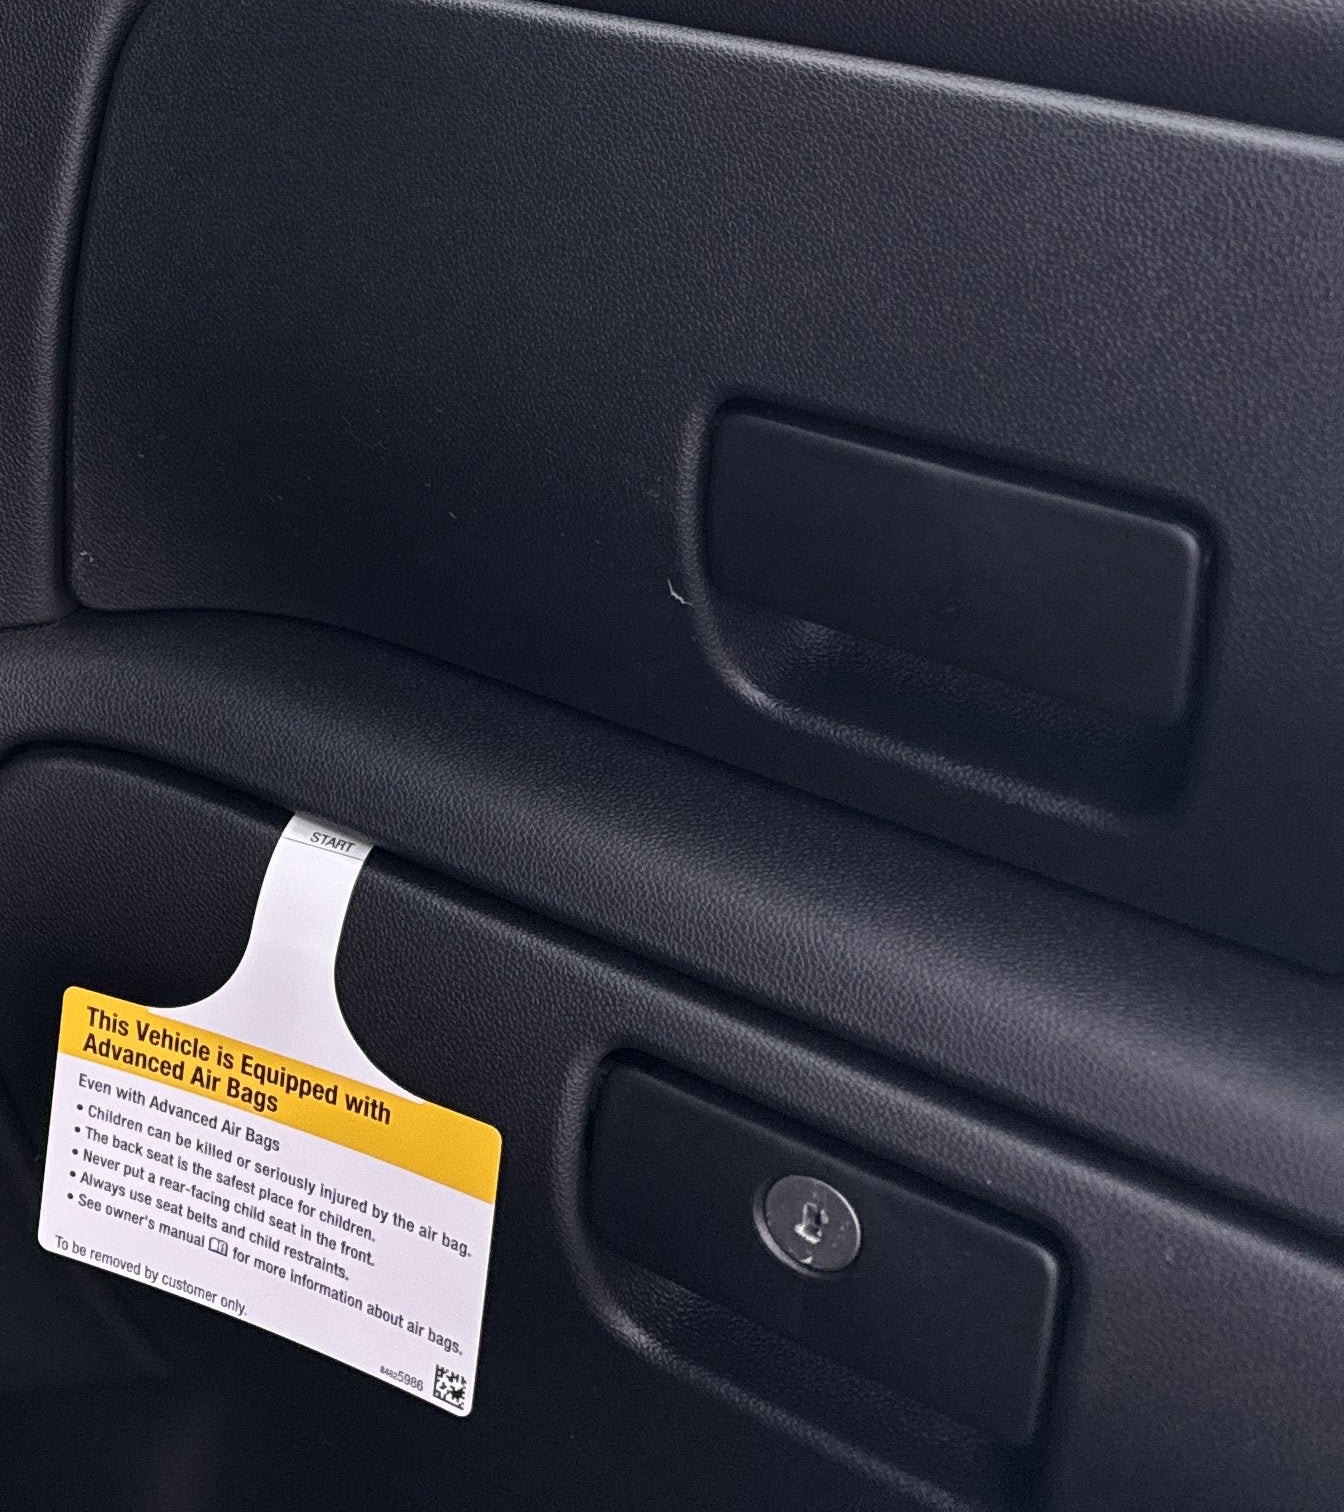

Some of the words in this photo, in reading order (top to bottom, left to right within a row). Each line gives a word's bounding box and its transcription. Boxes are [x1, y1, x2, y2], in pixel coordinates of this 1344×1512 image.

[310, 831, 357, 852] START
[82, 1032, 186, 1082] Advanced
[189, 1065, 222, 1093] Air
[226, 1075, 279, 1113] Bags
[86, 1005, 130, 1037] This
[135, 1019, 211, 1062] Vehicle
[216, 1044, 235, 1070] is
[240, 1053, 339, 1106] Equipped
[344, 1092, 391, 1126] with
[78, 1072, 112, 1096] Even
[115, 1086, 146, 1107] with
[148, 1095, 218, 1130] Advanced
[220, 1118, 243, 1138] Air
[245, 1126, 281, 1152] Bags
[79, 1171, 126, 1197] Always
[129, 1189, 153, 1206] use
[155, 1198, 184, 1218] seat
[186, 1205, 218, 1230] belts
[220, 1221, 246, 1240] and
[248, 1231, 281, 1253] child
[82, 1148, 122, 1172] Never
[122, 1163, 146, 1181] put
[147, 1172, 156, 1185] a
[158, 1175, 231, 1213] rear-facing
[233, 1201, 266, 1224] child
[267, 1215, 297, 1236] seat
[299, 1223, 312, 1242] in
[316, 1230, 337, 1251] the
[84, 1125, 109, 1145] The
[111, 1134, 144, 1157] back
[145, 1148, 175, 1167] seat
[176, 1155, 189, 1172] is
[192, 1161, 213, 1180] the
[215, 1172, 256, 1196] safest
[257, 1187, 294, 1210] place
[297, 1199, 317, 1218] for
[87, 1104, 143, 1134] Children
[146, 1125, 172, 1143] can
[175, 1131, 192, 1149] be
[195, 1138, 233, 1164] killed
[236, 1156, 252, 1170] or
[253, 1161, 317, 1196] seriously
[319, 1182, 368, 1215] injured
[371, 1203, 390, 1224] by
[391, 1211, 415, 1233] the
[418, 1225, 439, 1242] air
[54, 1234, 69, 1251] To
[71, 1240, 87, 1257] be
[89, 1249, 142, 1276] removed
[144, 1264, 160, 1284] by
[161, 1274, 219, 1304] customer
[77, 1193, 102, 1212] See
[105, 1204, 156, 1231] owner's
[158, 1222, 206, 1248] manual
[232, 1246, 251, 1265] for
[253, 1257, 287, 1279] more
[289, 1268, 363, 1312] information
[366, 1303, 405, 1329] about
[406, 1320, 426, 1337] air
